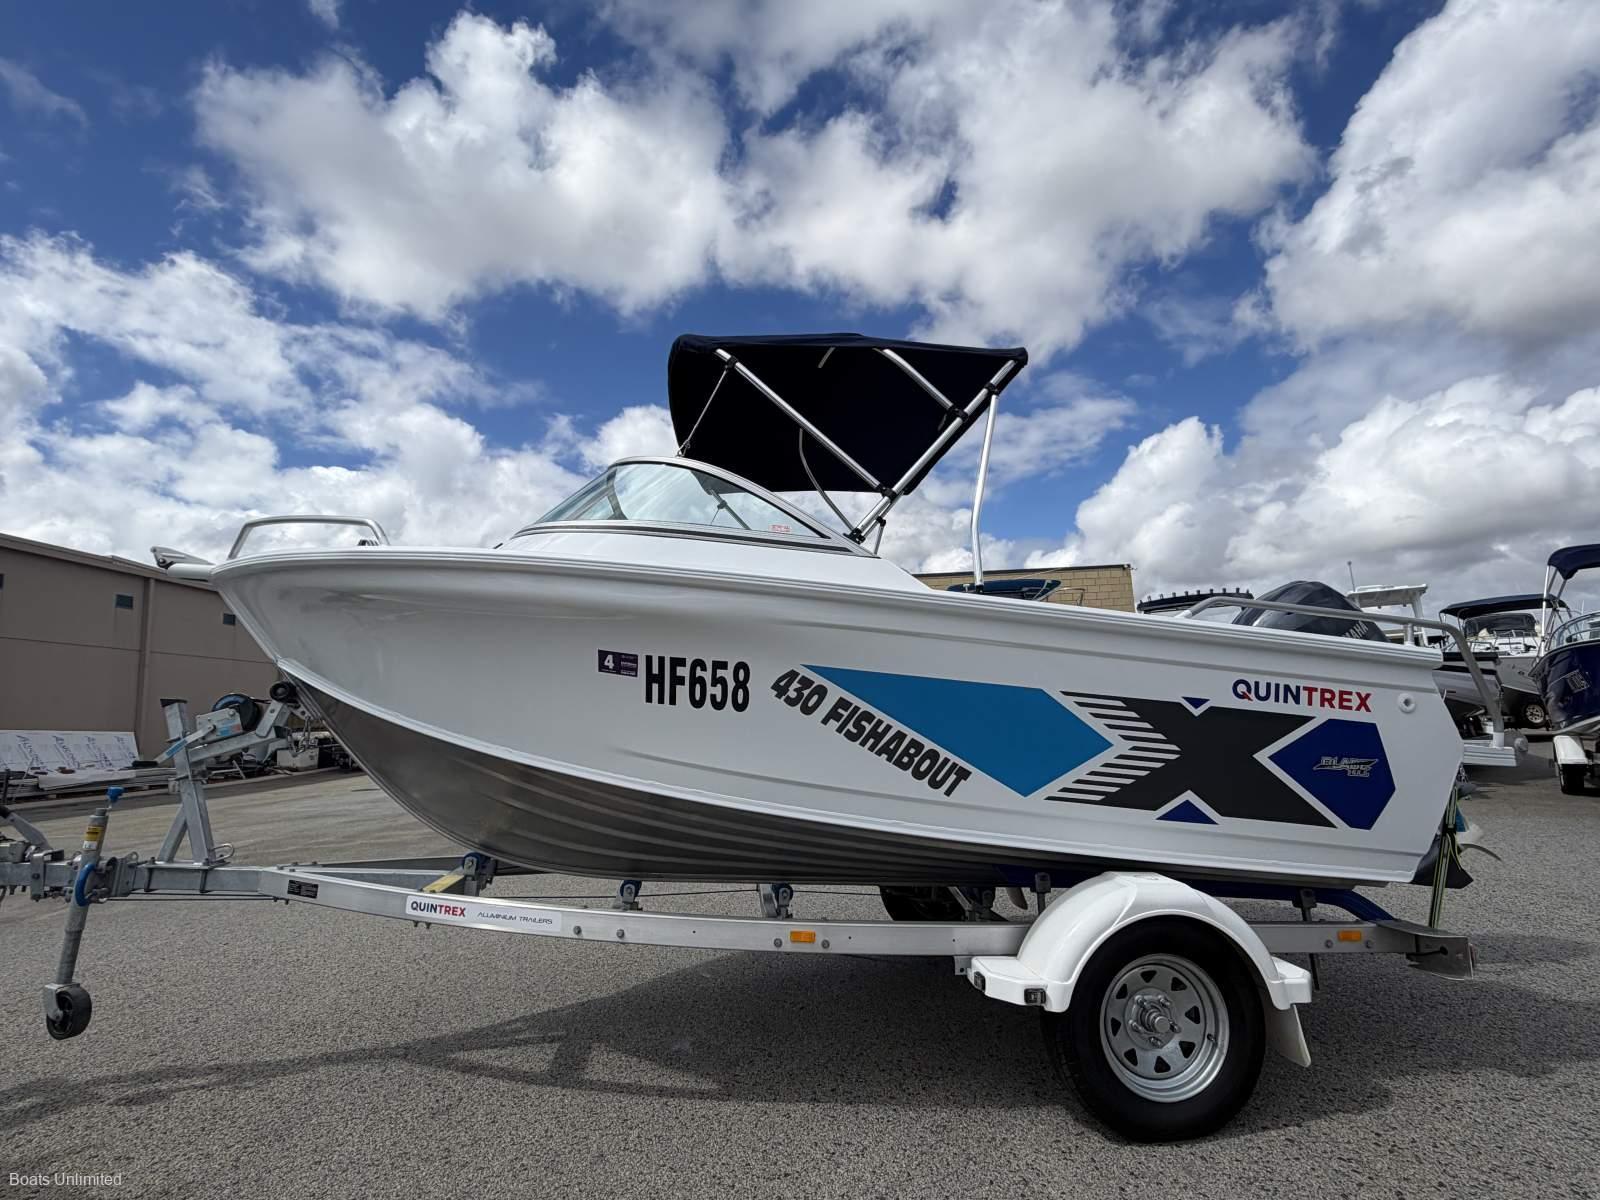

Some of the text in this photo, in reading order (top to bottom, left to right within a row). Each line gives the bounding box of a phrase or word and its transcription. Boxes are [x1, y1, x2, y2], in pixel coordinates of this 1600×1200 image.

[604, 654, 615, 669] 4
[645, 655, 750, 713] HF658
[1231, 678, 1372, 713] QUINTREX
[771, 669, 972, 798] 430 FISHABOUT
[410, 901, 466, 918] QUINTREX
[519, 916, 553, 925] TRAILERS
